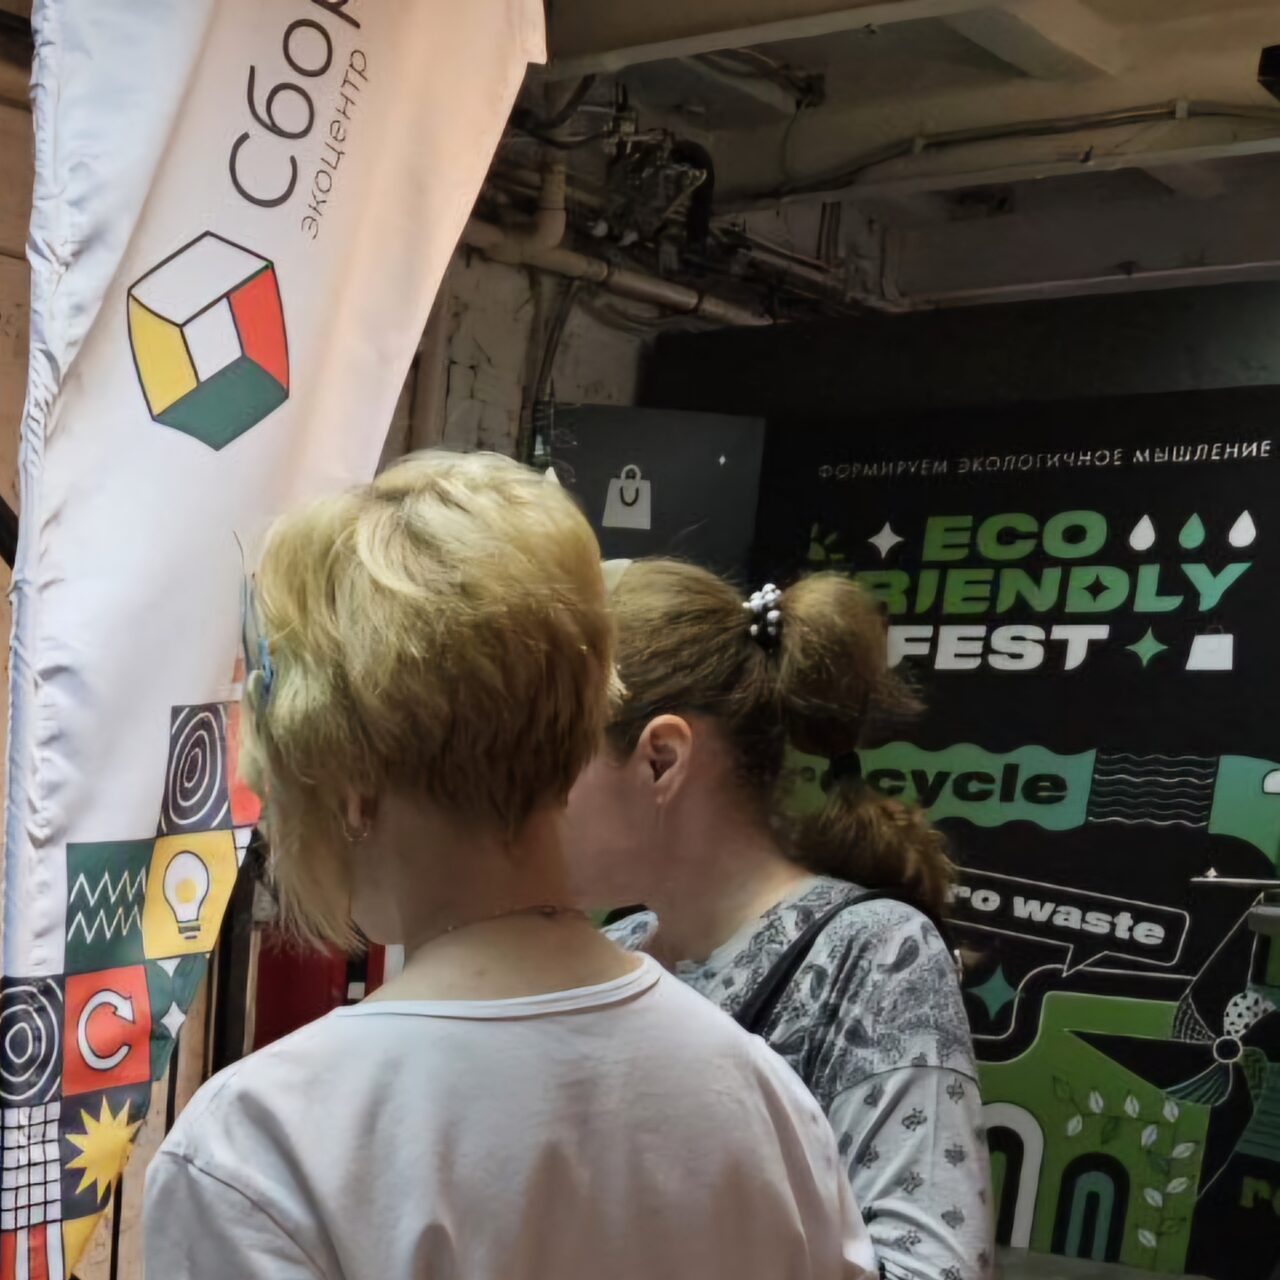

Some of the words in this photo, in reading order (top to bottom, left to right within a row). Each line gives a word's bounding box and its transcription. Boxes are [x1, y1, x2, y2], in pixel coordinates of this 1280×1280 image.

[301, 49, 369, 240] экоцентр
[819, 459, 947, 479] ФОРМИРУЕМ
[957, 448, 1123, 474] ЭКОЛОГИЧНОЕ
[1133, 440, 1272, 464] МЫШЛЕНИЕ
[922, 510, 1108, 562] ECO
[853, 562, 1253, 615] RIENDLY
[886, 624, 1110, 671] FEST
[808, 763, 1068, 809] cycle
[1013, 897, 1165, 944] waste
